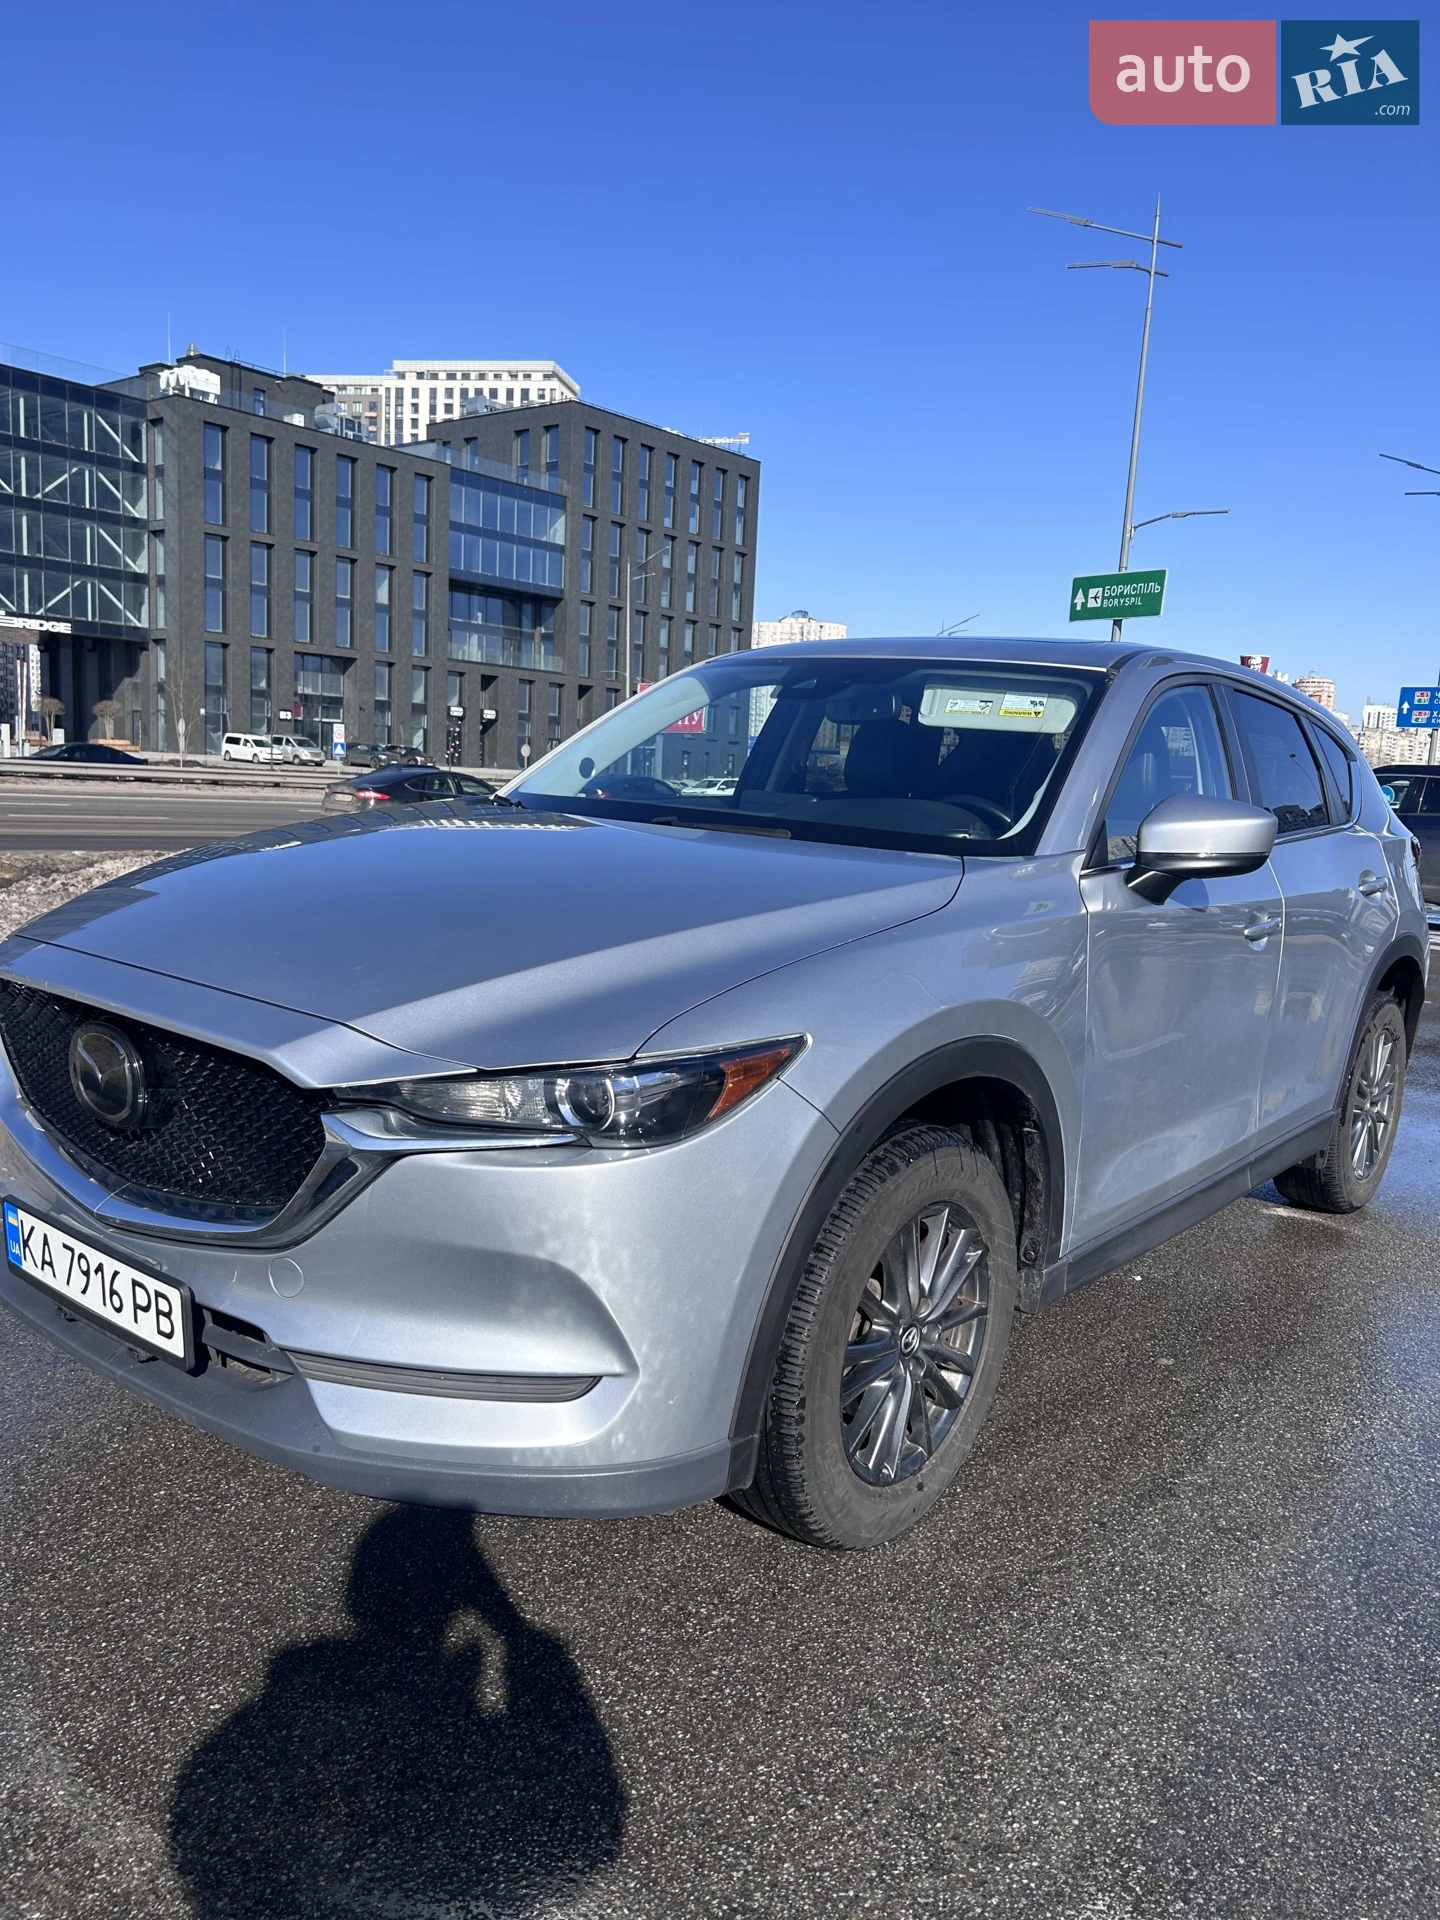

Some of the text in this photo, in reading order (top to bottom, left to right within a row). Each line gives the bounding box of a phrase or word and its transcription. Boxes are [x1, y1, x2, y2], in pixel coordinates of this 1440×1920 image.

[1104, 582, 1161, 597] БОРИСПІЛЬ
[1103, 597, 1142, 608] BORYSPIL
[9, 1239, 21, 1257] UA
[20, 1219, 175, 1340] KA 7916 PB
